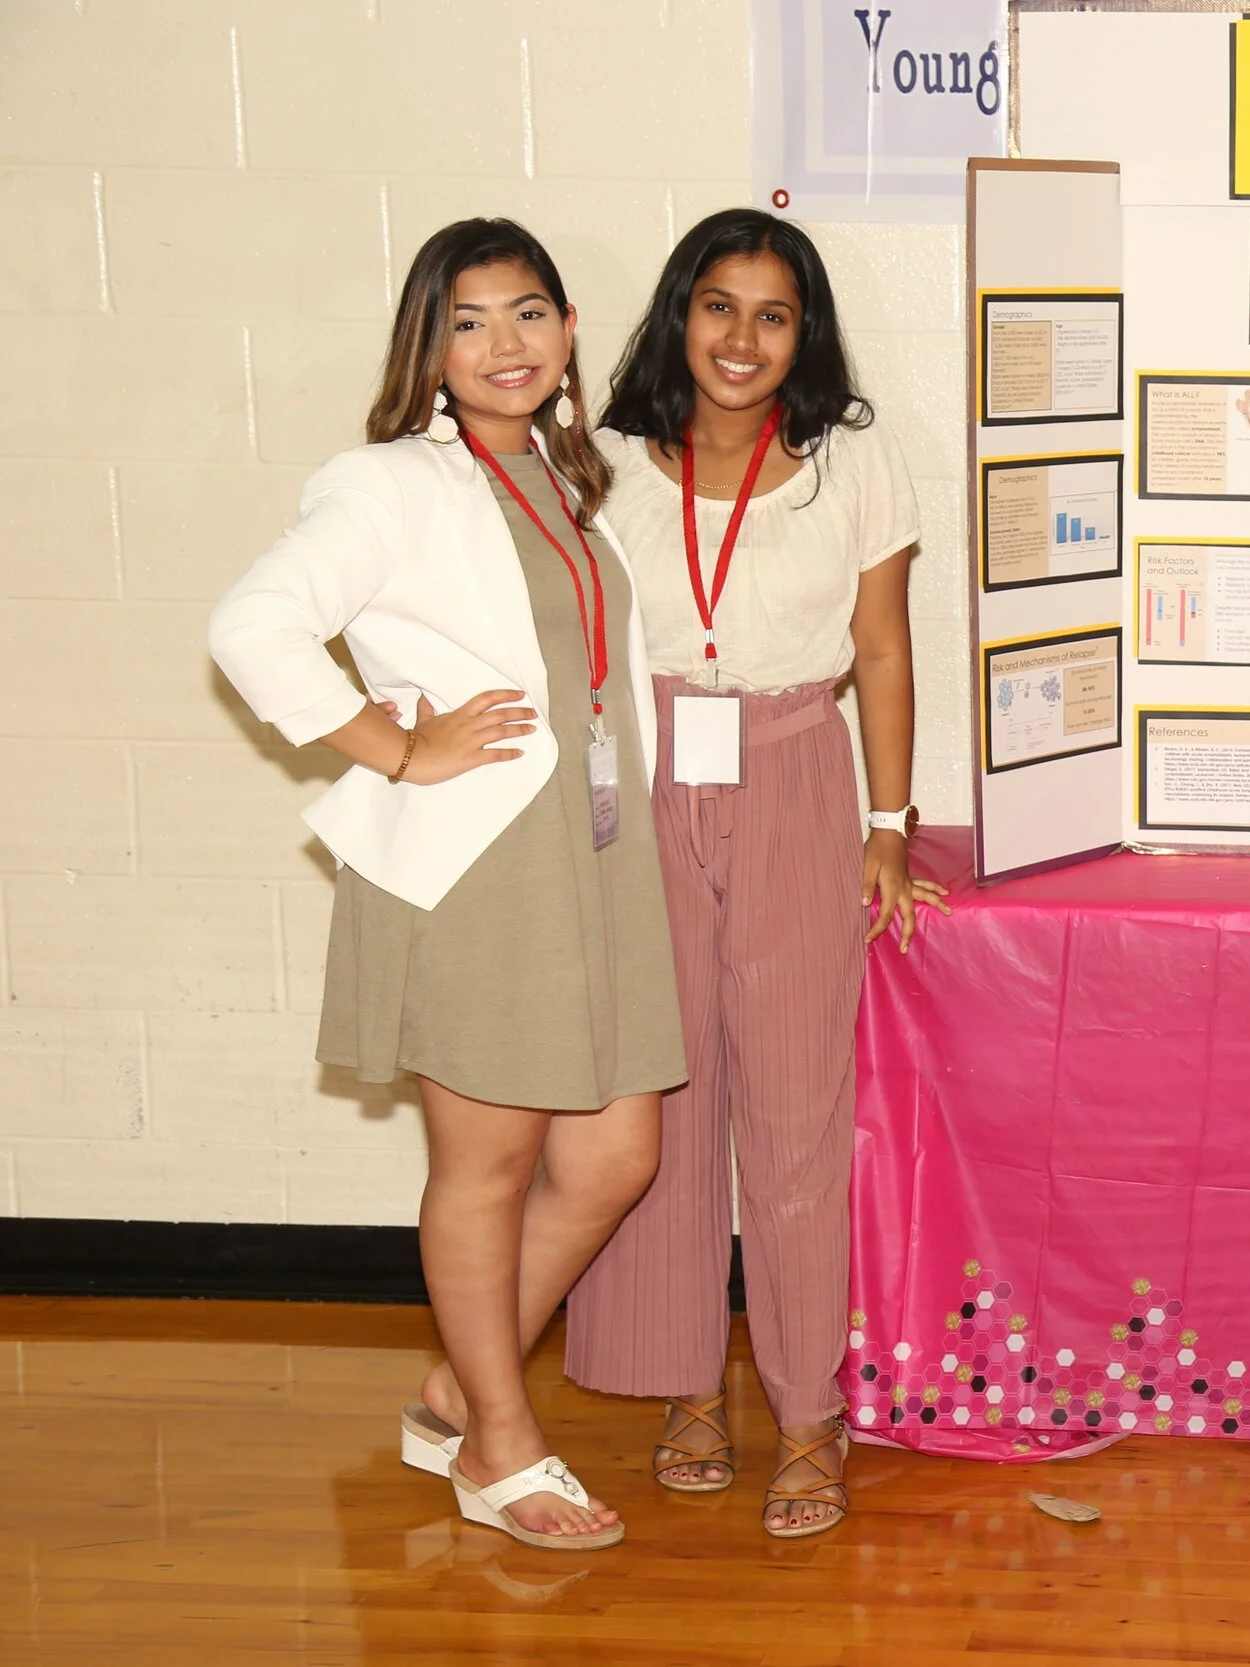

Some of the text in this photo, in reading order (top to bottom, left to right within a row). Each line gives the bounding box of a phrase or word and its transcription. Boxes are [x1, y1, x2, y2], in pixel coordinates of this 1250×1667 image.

[854, 9, 1000, 115] Young
[992, 310, 1032, 320] Demographics
[999, 474, 1038, 484] Demographics
[1148, 556, 1194, 565] Risk Factors
[1166, 568, 1199, 576] Outlook
[992, 664, 1003, 672] Risk
[1005, 661, 1018, 670] and
[1019, 654, 1060, 668] Mechanisms
[1061, 652, 1069, 661] of
[1149, 727, 1208, 737] References
